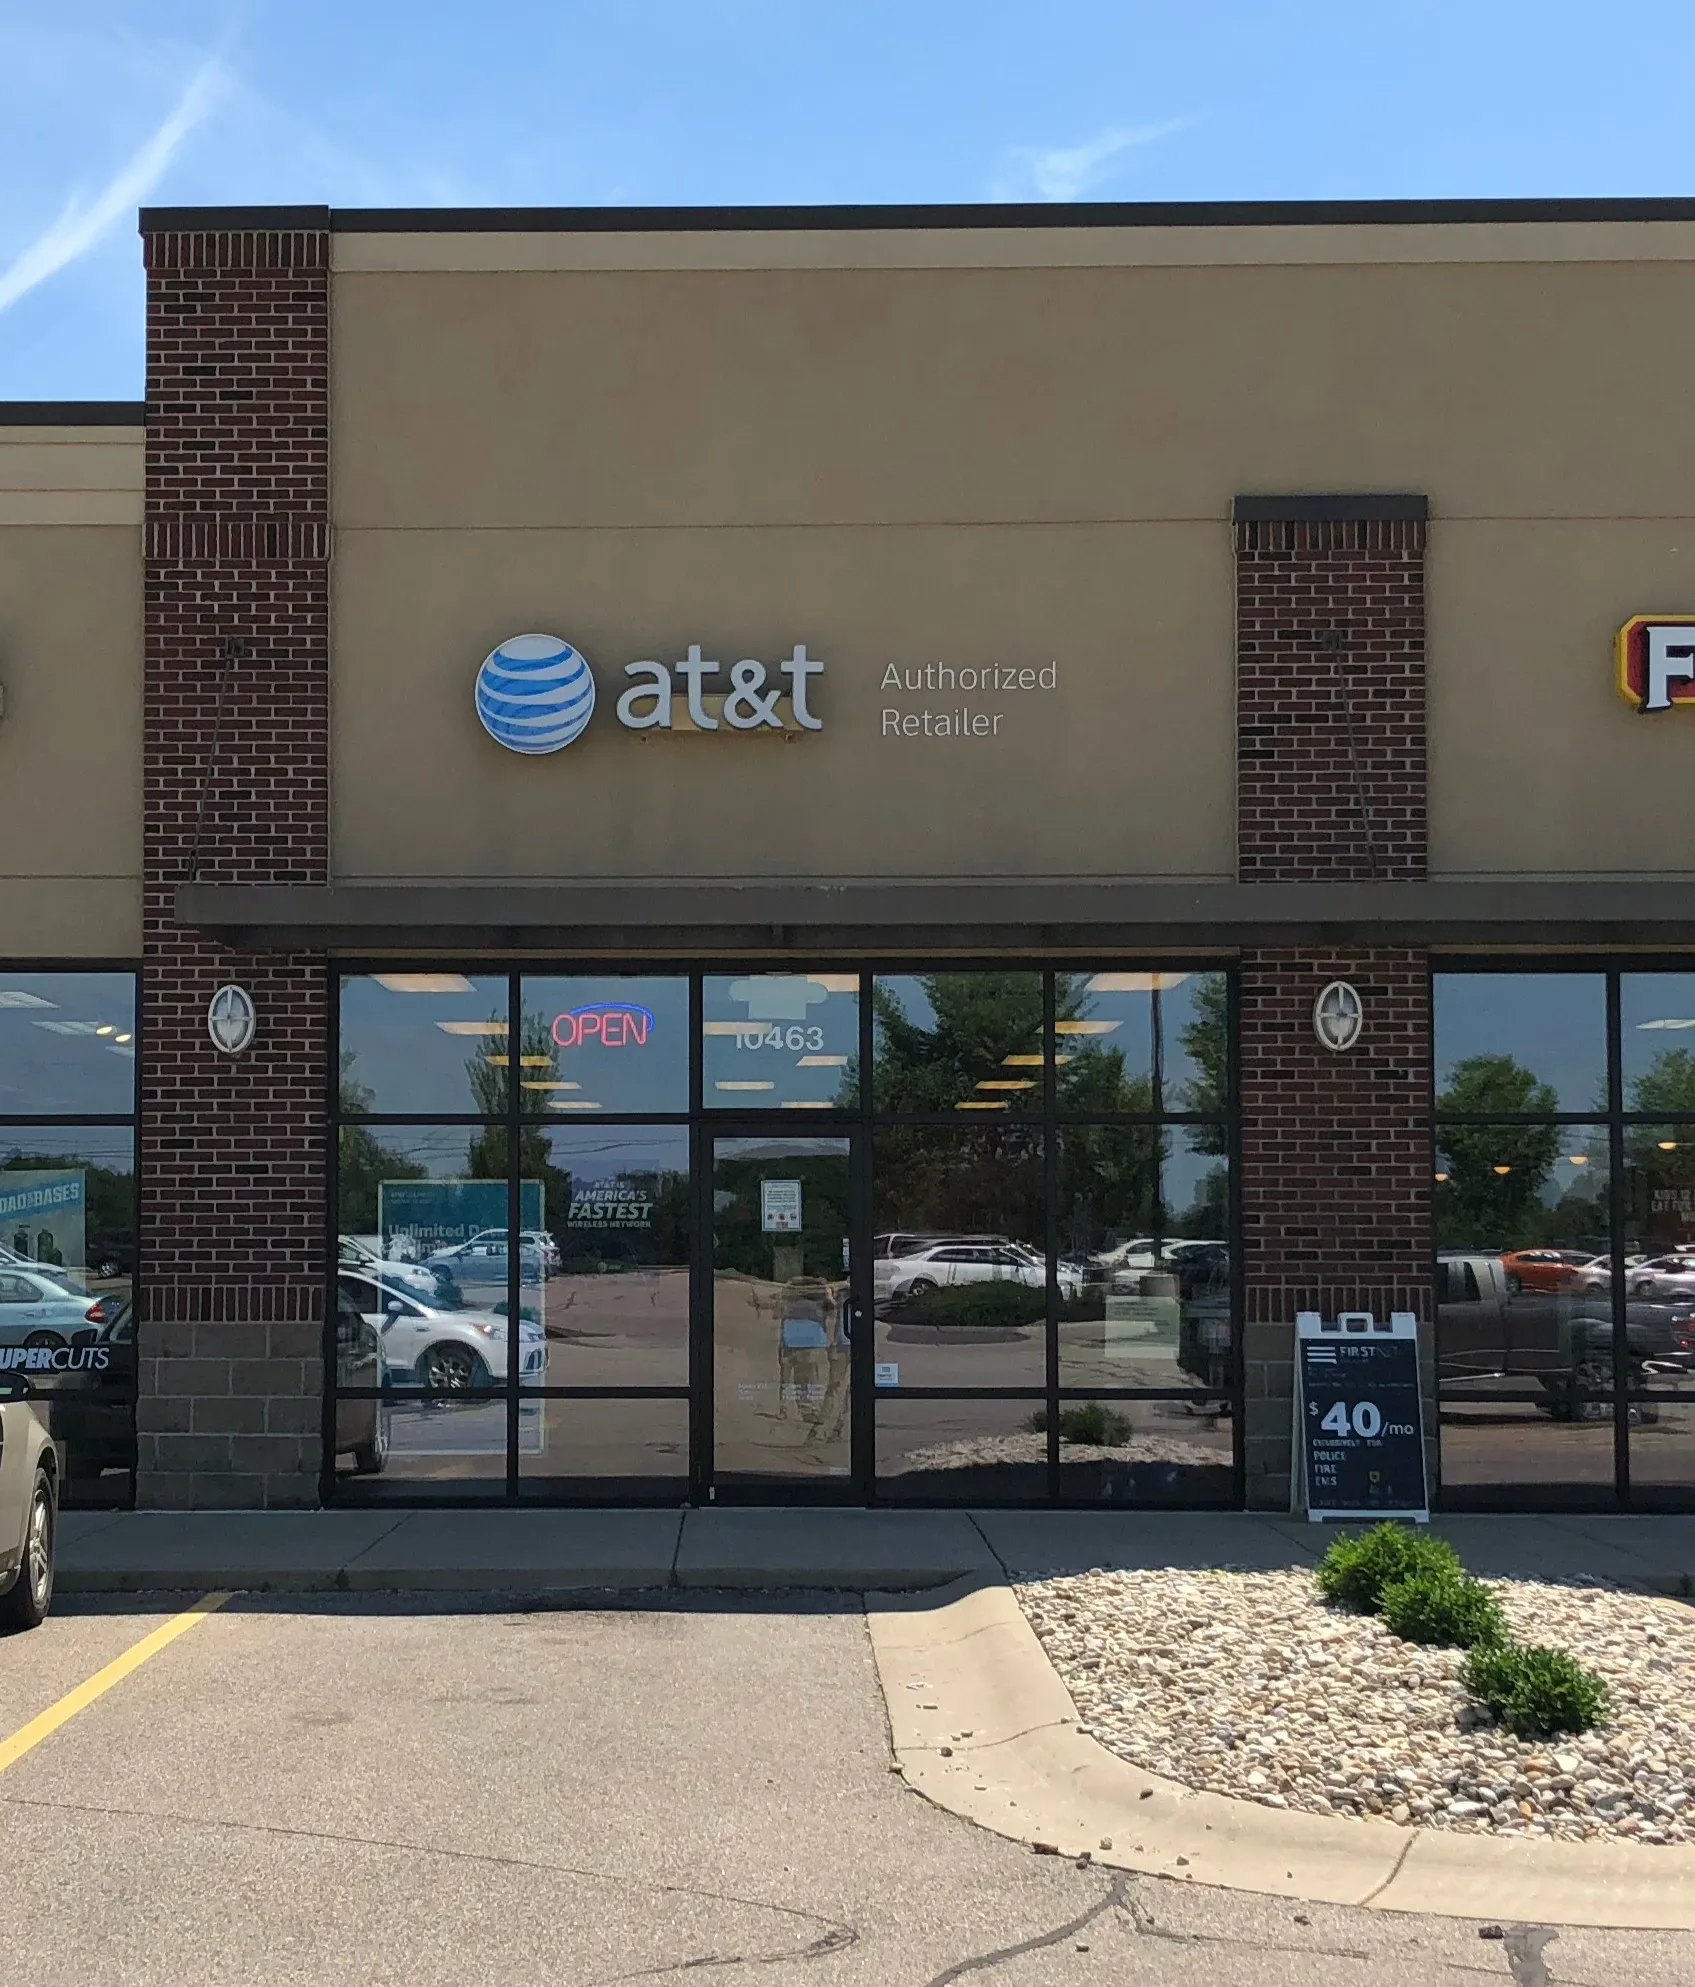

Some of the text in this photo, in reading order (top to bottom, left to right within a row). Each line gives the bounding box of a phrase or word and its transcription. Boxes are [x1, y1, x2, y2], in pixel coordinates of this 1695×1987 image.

[615, 644, 825, 730] at&t
[880, 660, 1058, 691] Authorized
[881, 707, 1005, 737] Retailer
[551, 1012, 648, 1047] OPEN
[736, 1025, 824, 1051] 10463
[34, 1182, 81, 1207] BASES
[574, 1189, 648, 1202] AMERICA'S
[568, 1202, 654, 1220] FASTEST
[388, 1222, 465, 1239] Unlimited
[566, 1220, 652, 1229] WIRELESS NETWORK
[0, 1347, 110, 1370] UPERCUTS
[1313, 1450, 1346, 1461] POLICE
